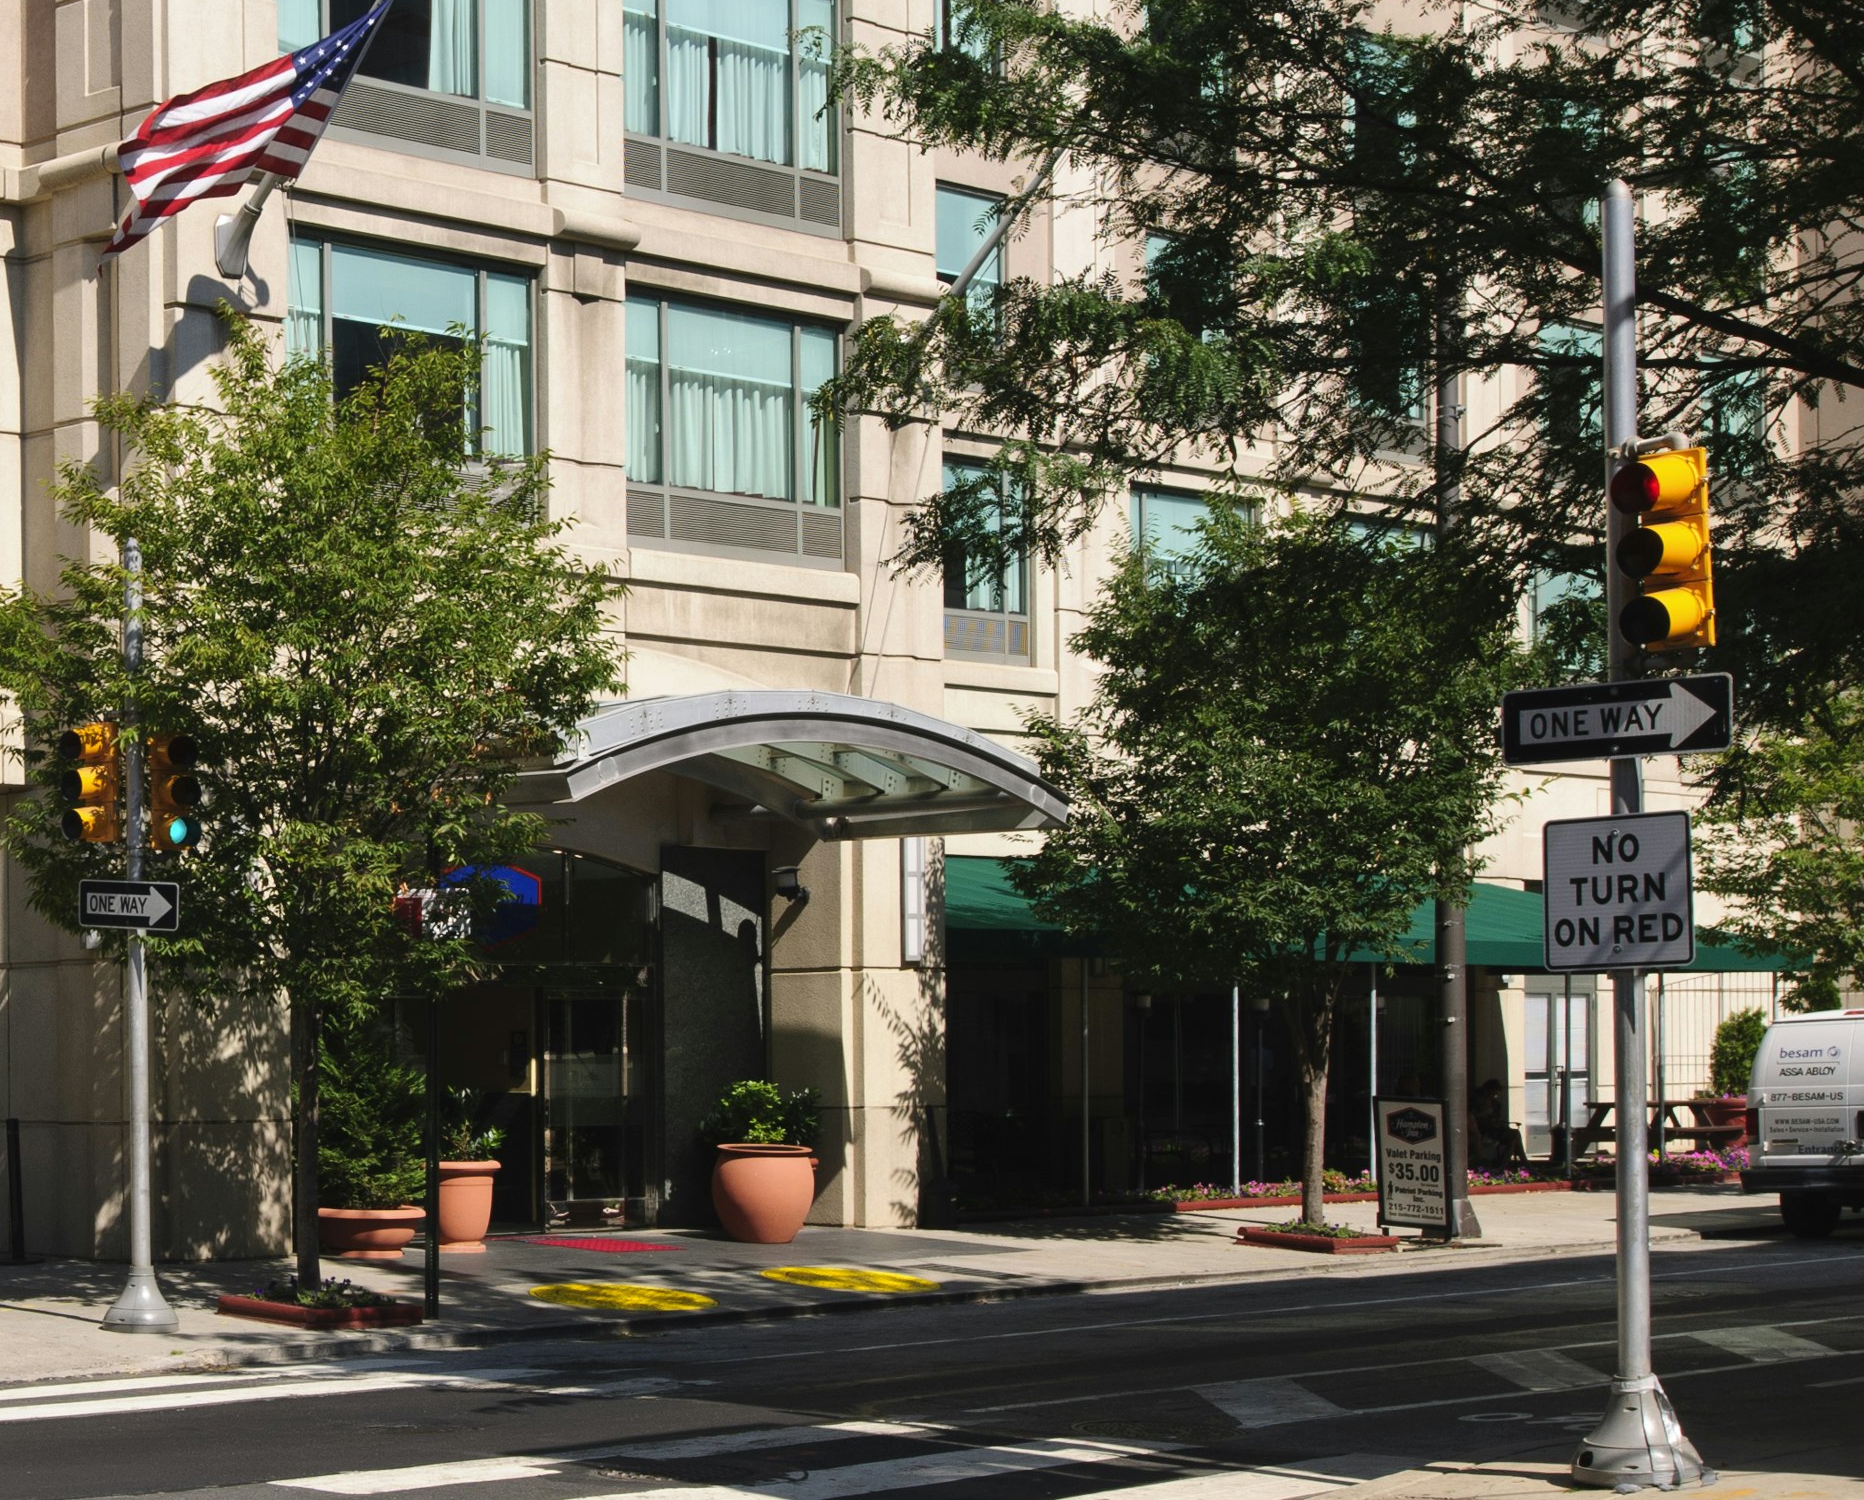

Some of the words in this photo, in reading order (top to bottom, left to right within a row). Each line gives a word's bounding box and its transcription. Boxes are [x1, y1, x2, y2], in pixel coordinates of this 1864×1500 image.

[1530, 710, 1589, 740] ONE
[1599, 703, 1664, 734] WAY
[1592, 833, 1640, 865] NO
[1569, 872, 1666, 906] TURN
[89, 894, 116, 913] ONE
[119, 896, 148, 914] WAY
[1554, 916, 1600, 948] ON
[1613, 912, 1684, 945] RED
[1779, 1047, 1823, 1059] besam
[1778, 1067, 1804, 1077] ASSA
[1805, 1066, 1836, 1076] ABLOY
[1770, 1091, 1844, 1102] 877-BESAM-US
[1394, 1118, 1431, 1131] Hampton
[1386, 1148, 1408, 1159] Valet
[1409, 1150, 1441, 1163] Parking
[1388, 1162, 1439, 1182] $35.00
[1394, 1185, 1417, 1194] Patriot
[1417, 1188, 1443, 1199] Parking
